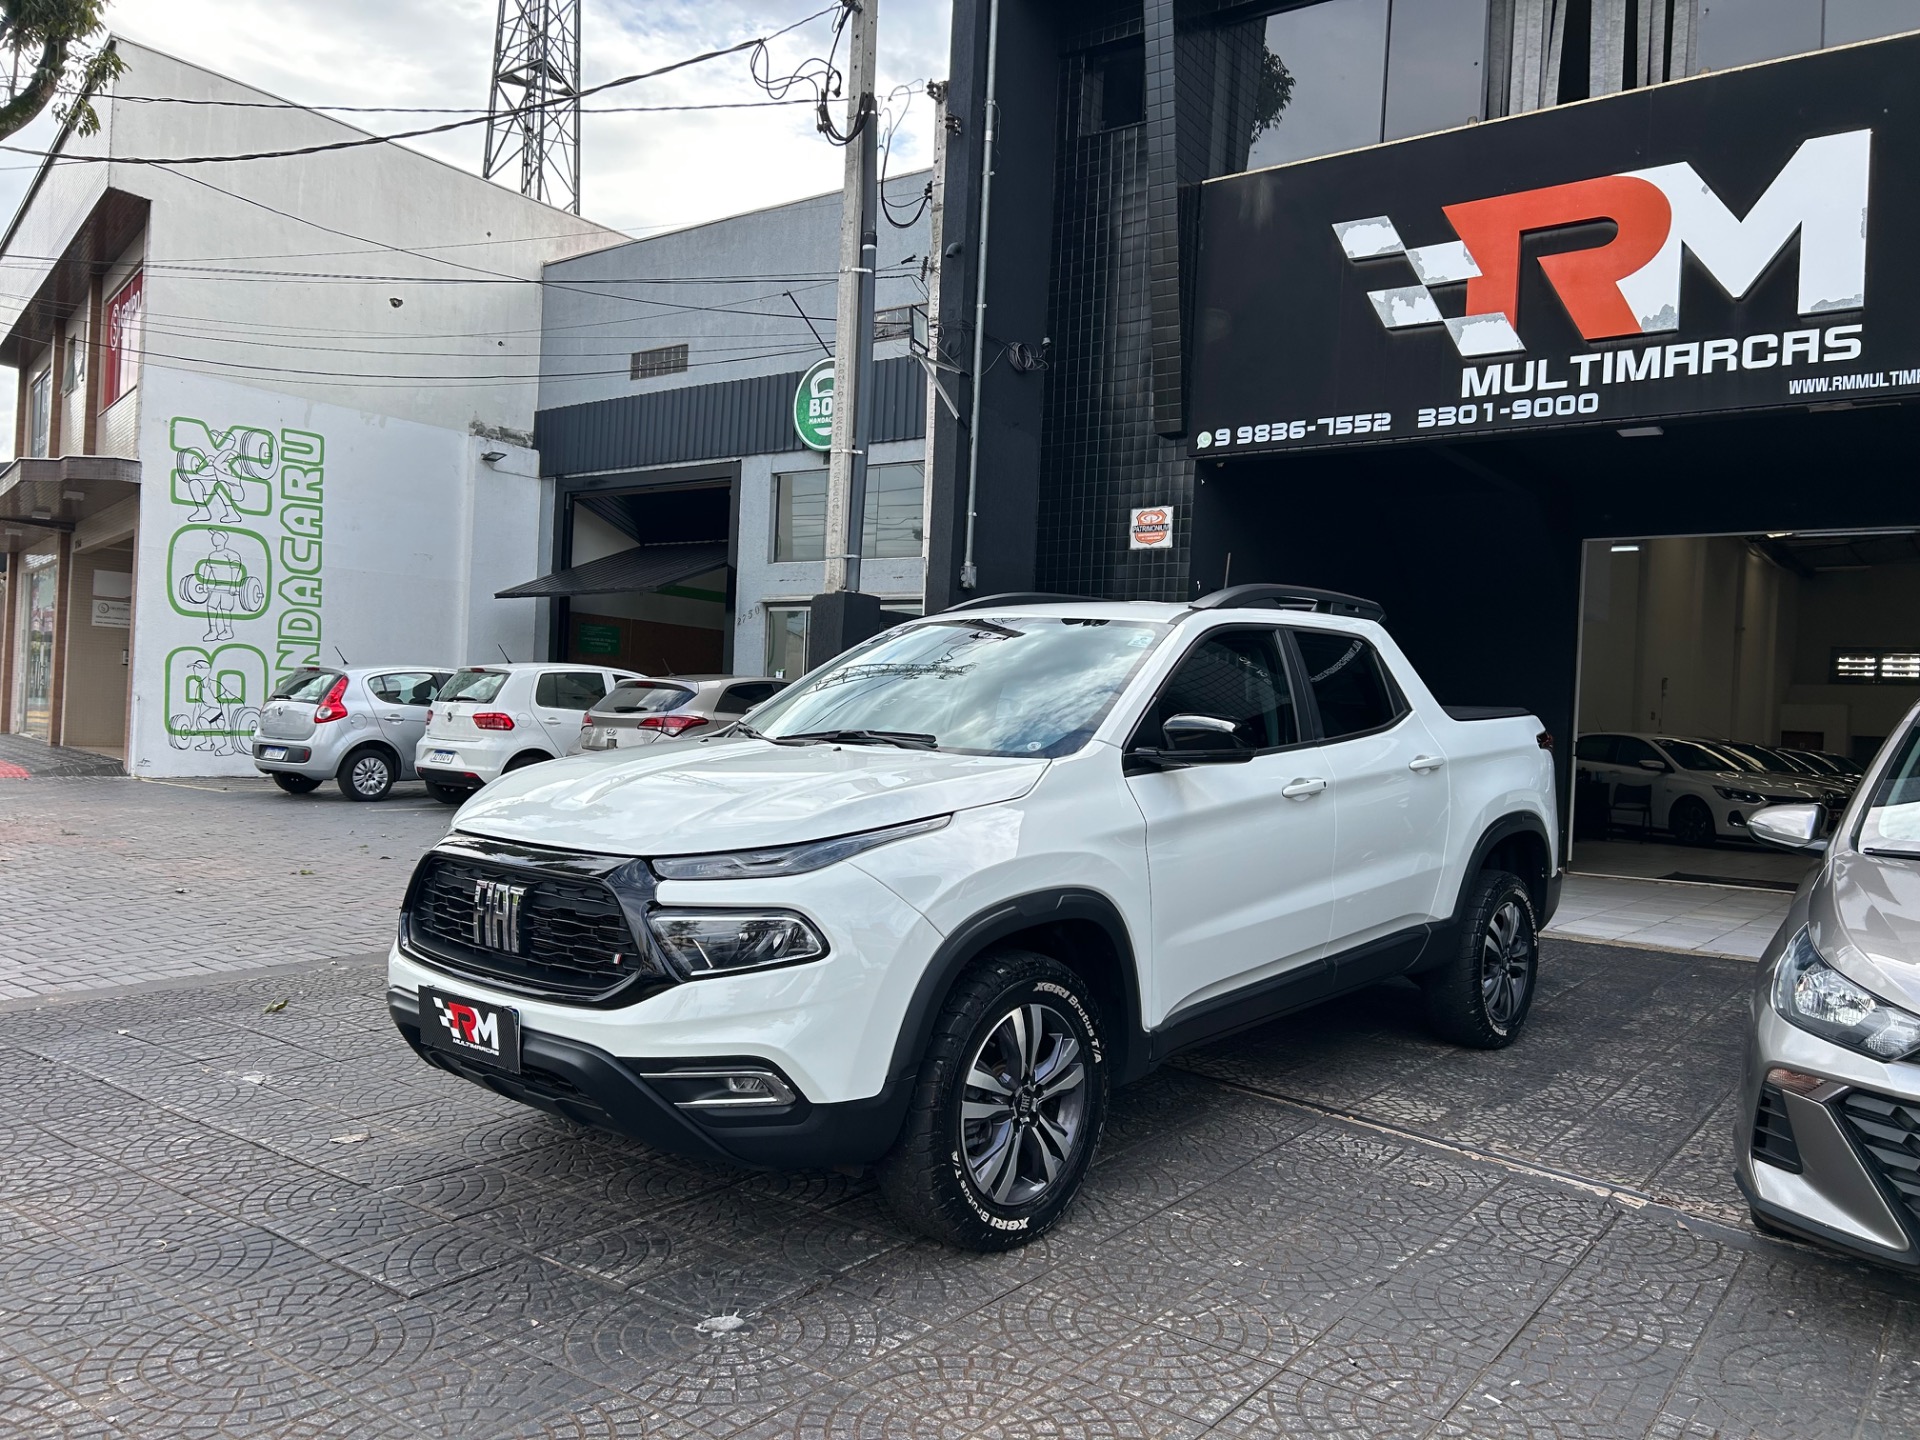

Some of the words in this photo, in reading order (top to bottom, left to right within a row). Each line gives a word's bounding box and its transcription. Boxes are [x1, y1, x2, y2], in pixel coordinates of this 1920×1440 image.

[1442, 128, 1871, 341] RM
[1461, 324, 1863, 398] MULTIMARCAS
[809, 397, 833, 417] BO
[1214, 428, 1231, 446] 9
[1236, 413, 1392, 445] 9836-7552
[1417, 392, 1599, 429] 3301-9000
[164, 416, 273, 737] BOX
[274, 428, 325, 690] NDACARU
[474, 880, 527, 953] FIAT
[448, 1001, 500, 1051] RM
[452, 1037, 500, 1057] MULTIMARCAS
[1033, 982, 1071, 999] XBRI
[1068, 995, 1095, 1037] Brutus
[1091, 1038, 1102, 1064] T/A
[951, 1150, 962, 1179] T/A
[960, 1179, 990, 1223] Brutus
[989, 1216, 1030, 1231] XBRI
